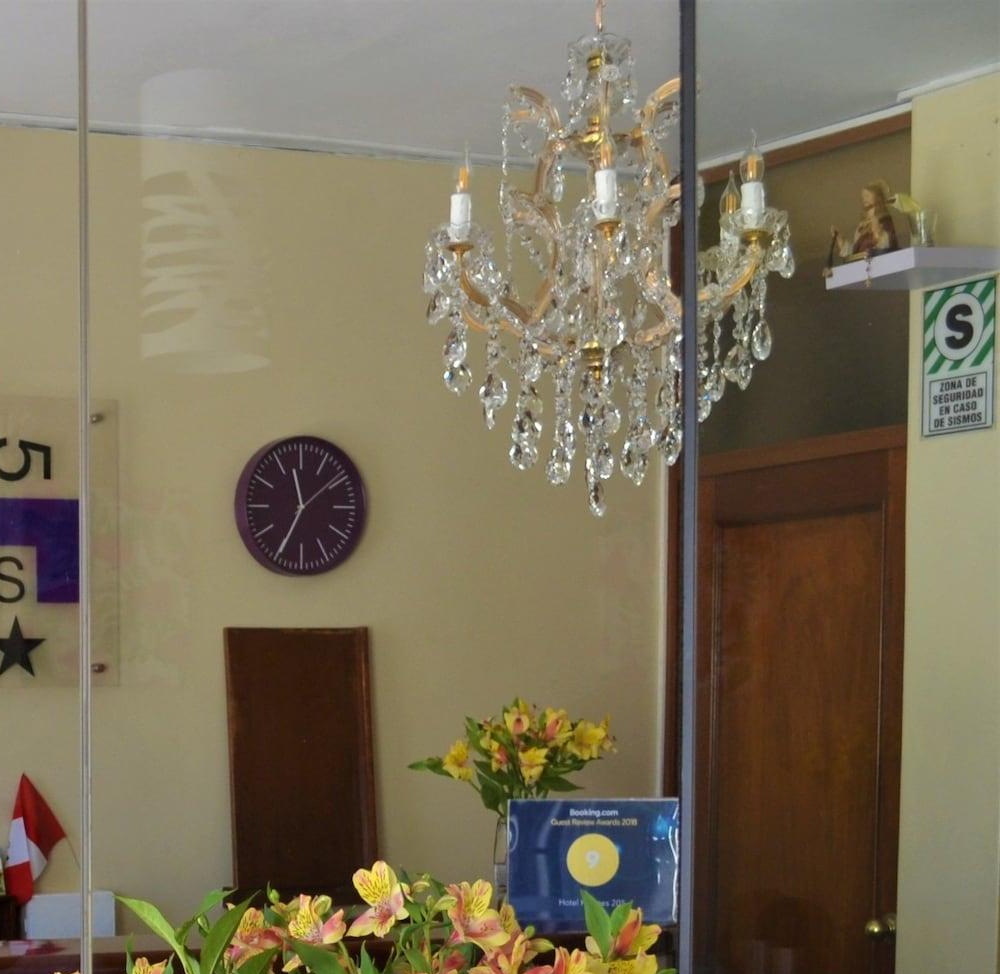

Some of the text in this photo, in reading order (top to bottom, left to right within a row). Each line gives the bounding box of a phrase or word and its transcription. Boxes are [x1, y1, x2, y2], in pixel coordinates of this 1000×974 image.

[944, 303, 975, 351] S
[939, 376, 977, 393] ZONA DE
[932, 387, 984, 406] SEGURIDAD
[939, 400, 977, 416] EN CASO
[933, 411, 983, 429] DE SISMOS
[569, 808, 619, 817] Booking.com
[551, 818, 571, 826] Guest
[571, 818, 595, 826] Review
[596, 818, 620, 826] Awards
[558, 898, 580, 907] Hotel
